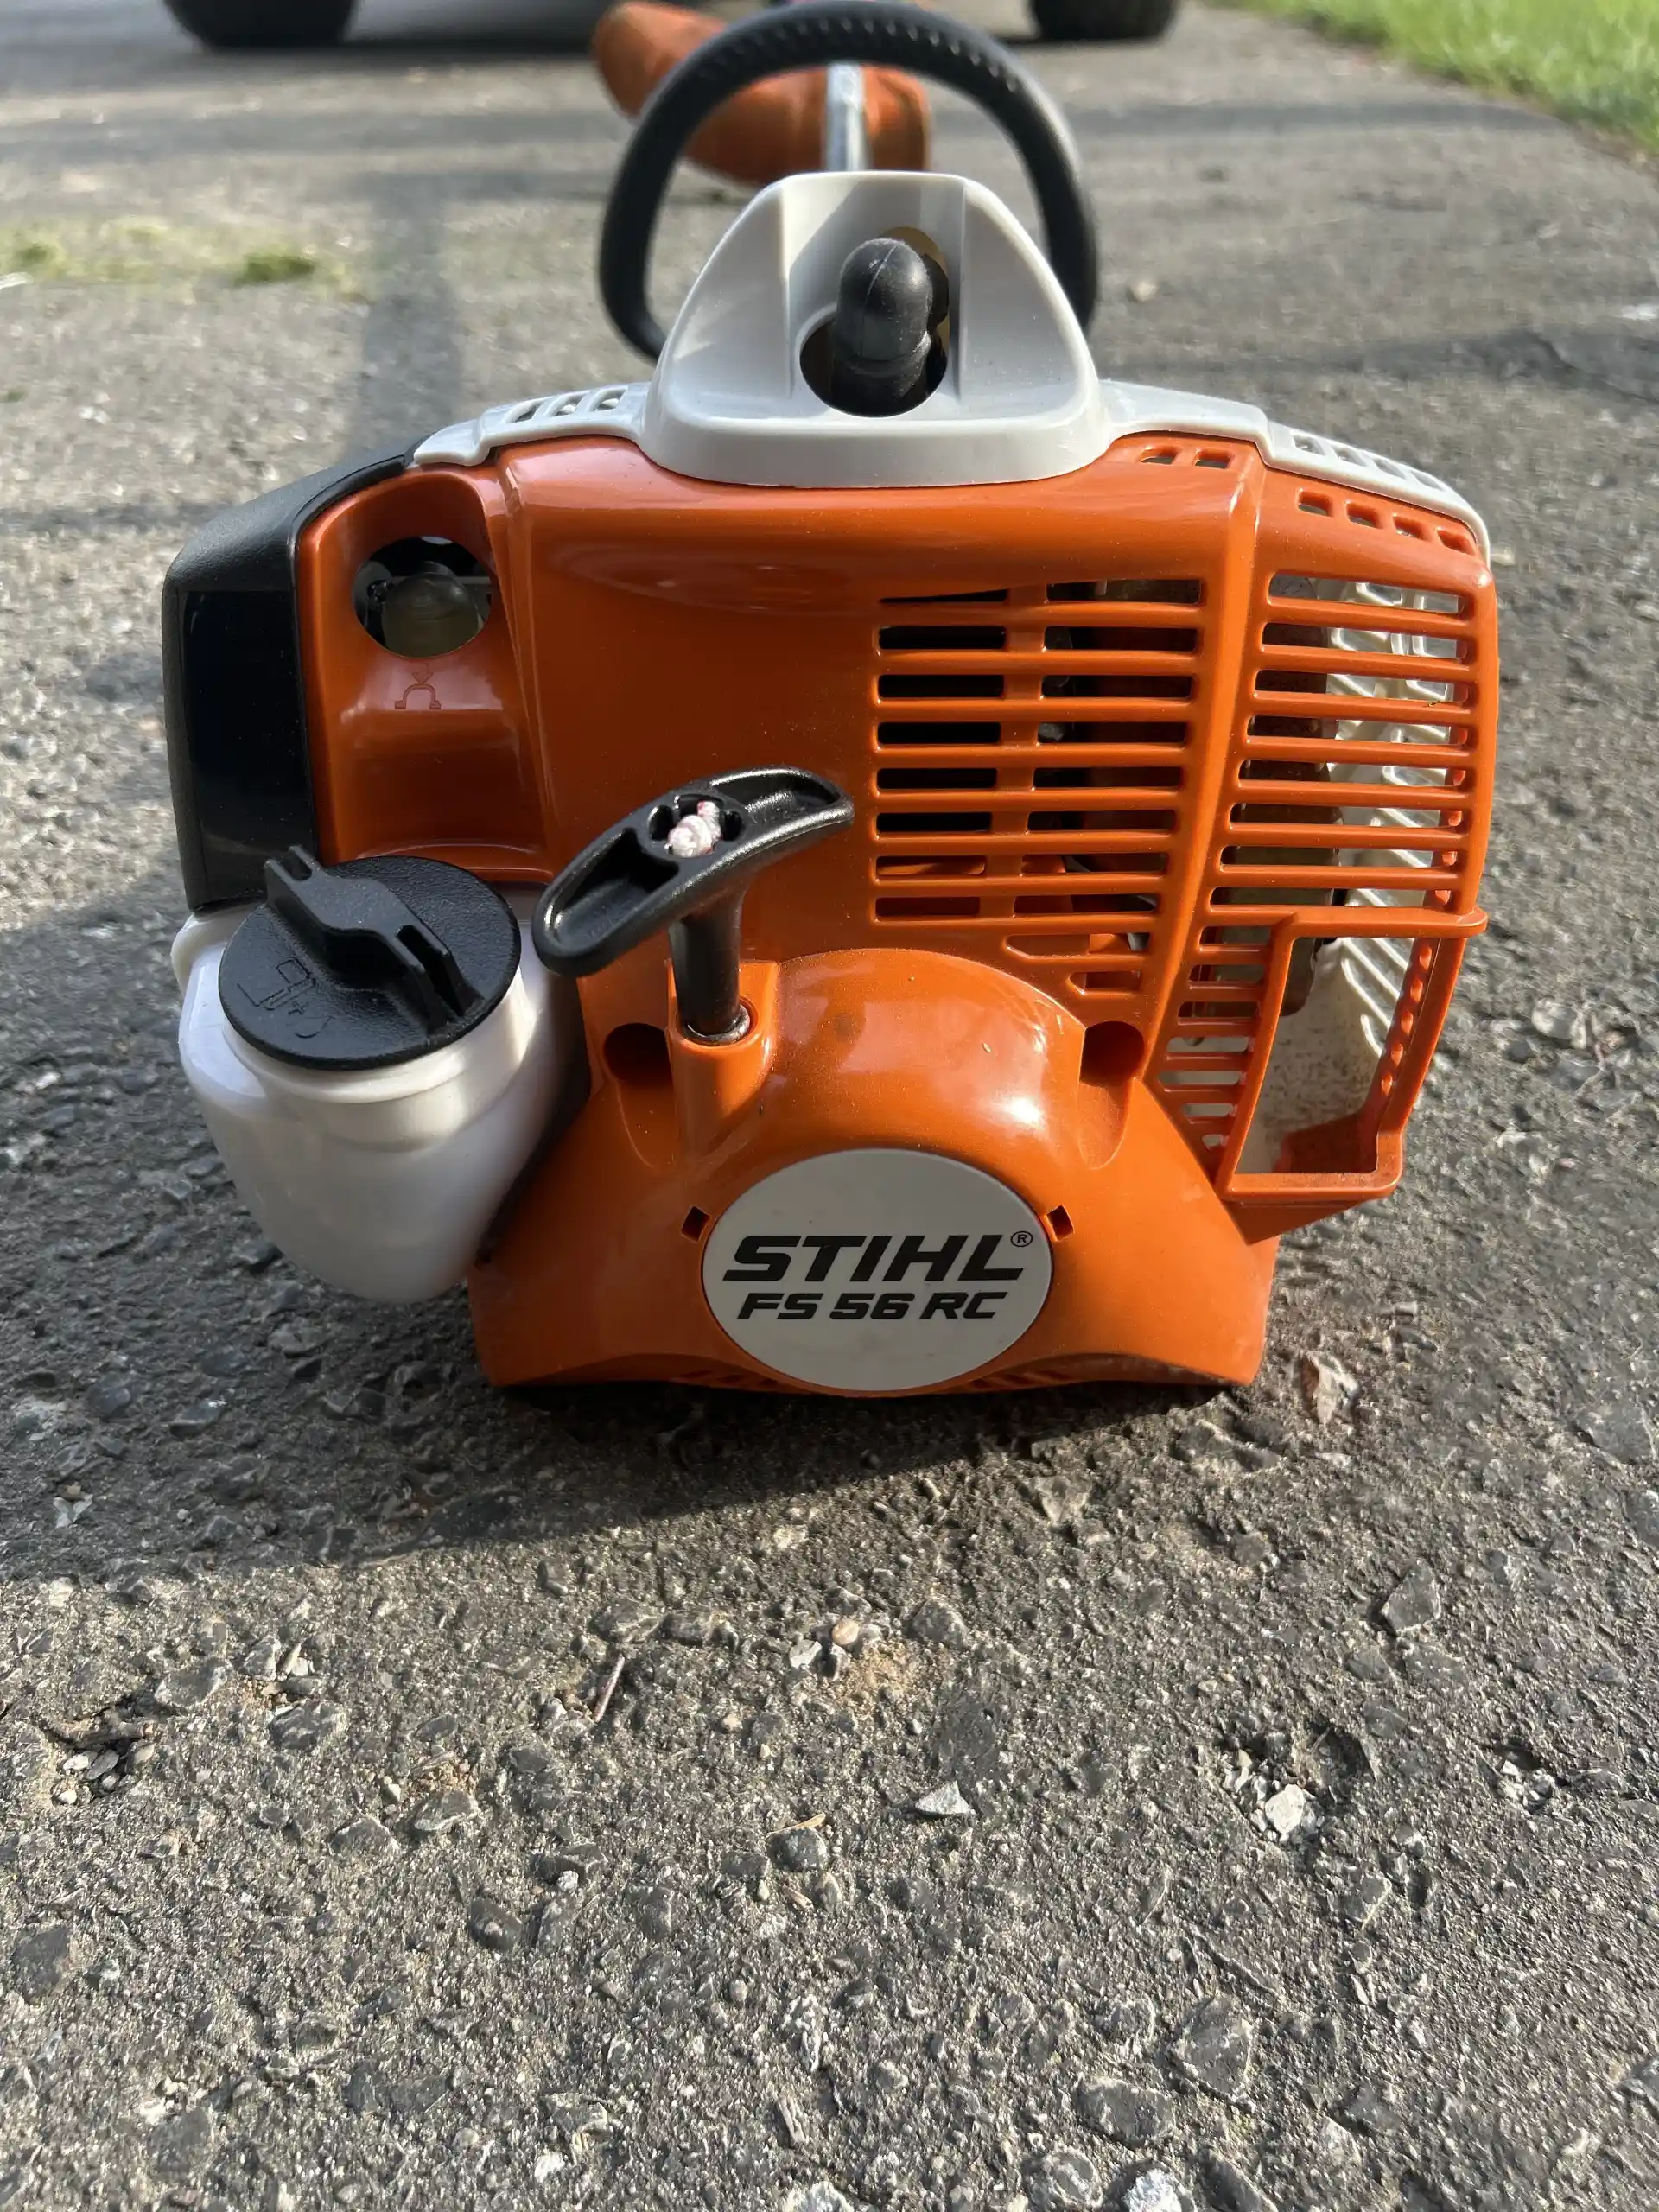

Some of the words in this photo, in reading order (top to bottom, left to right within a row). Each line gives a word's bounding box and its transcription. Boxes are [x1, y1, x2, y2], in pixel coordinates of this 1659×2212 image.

[737, 1292, 823, 1320] FS
[829, 1292, 916, 1320] 56
[918, 1291, 1008, 1320] RC
